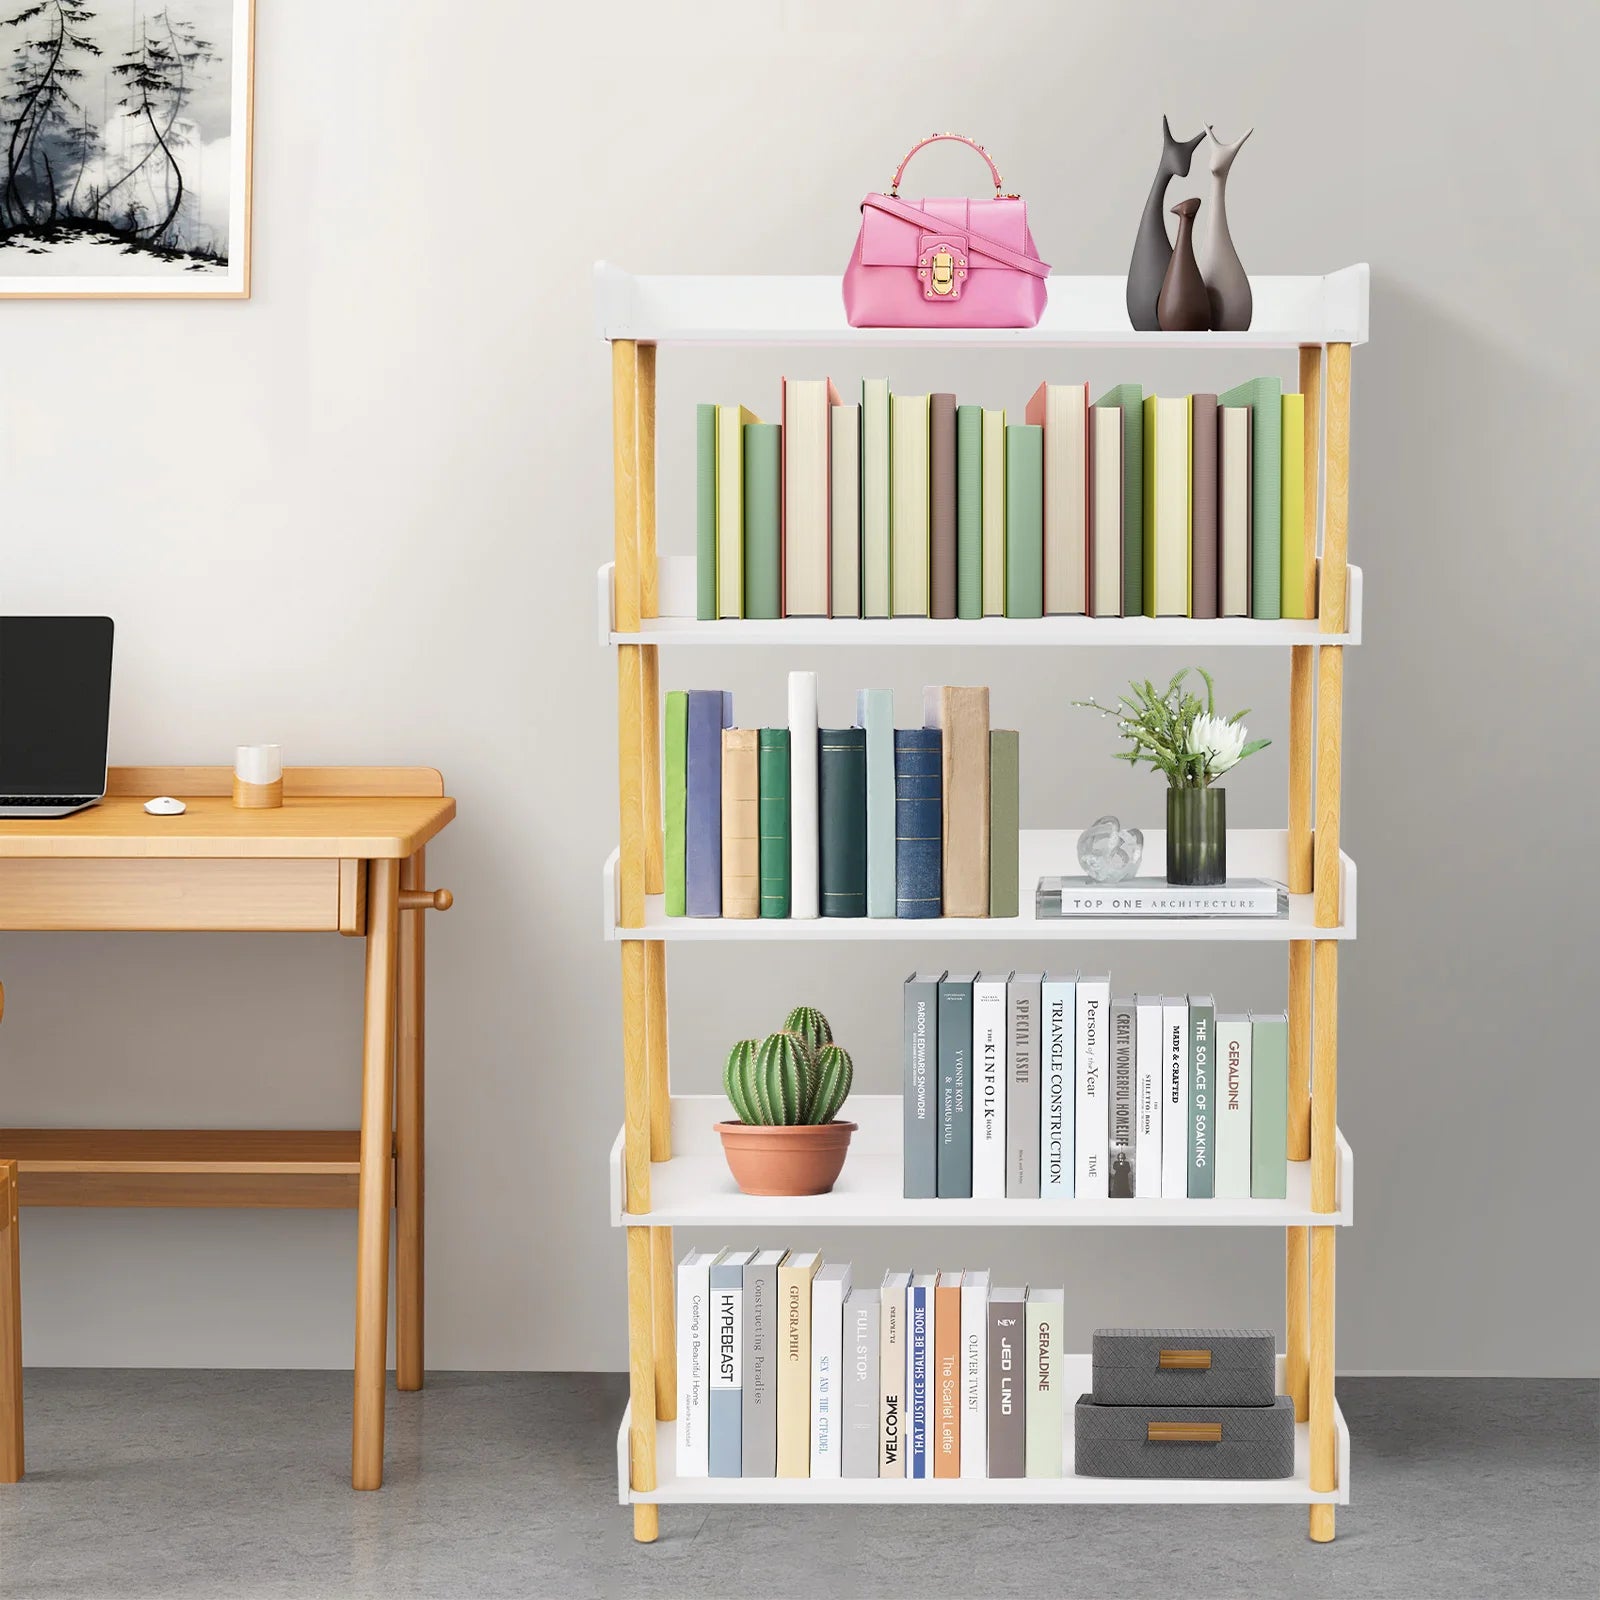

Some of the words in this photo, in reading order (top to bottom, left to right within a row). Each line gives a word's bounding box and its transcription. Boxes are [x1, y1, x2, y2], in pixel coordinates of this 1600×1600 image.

[1074, 900, 1103, 909] TOP
[1112, 900, 1142, 909] ONE
[1151, 900, 1255, 908] ARCHITECTURE
[917, 1001, 926, 1034] PARDON
[1015, 999, 1029, 1047] SPECIAL
[1087, 1000, 1099, 1046] Person
[1116, 1013, 1130, 1045] CREATE
[1195, 1019, 1206, 1041] THE
[1051, 1000, 1063, 1071] TRIANGLE
[1085, 1047, 1094, 1056] of
[1172, 1025, 1180, 1053] MADE
[917, 1035, 926, 1072] EDWARD
[1015, 1052, 1029, 1084] ISSUE
[1172, 1053, 1180, 1061] &
[1195, 1045, 1206, 1090] SOLACE
[945, 1076, 952, 1084] &
[984, 1044, 995, 1118] KINFOLK
[1087, 1067, 1099, 1098] Year
[1116, 1047, 1129, 1101] WONDERFUL
[1171, 1062, 1180, 1104] CRAFTED
[1228, 1040, 1240, 1111] GERALDINE
[917, 1074, 926, 1120] SNOWDEN
[944, 1088, 952, 1122] RASMUS
[1195, 1094, 1206, 1110] OF
[944, 1123, 952, 1145] JUUL
[1050, 1074, 1063, 1185] CONSTRUCTION
[1115, 1103, 1129, 1147] HOMELIFE
[1195, 1115, 1206, 1168] SOAKING
[1088, 1154, 1097, 1178] TIME
[691, 1295, 701, 1331] Creating
[753, 1279, 765, 1351] Constructing
[857, 1310, 867, 1342] FULL
[915, 1307, 925, 1334] DONE
[997, 1319, 1016, 1327] NEW
[720, 1295, 734, 1382] HYPEBEAST
[915, 1335, 925, 1347] BE
[969, 1334, 978, 1375] OLIVER
[1001, 1337, 1012, 1371] JED
[692, 1340, 701, 1378] Beautiful
[819, 1356, 829, 1372] SEX
[856, 1345, 867, 1382] STOP.
[914, 1349, 925, 1379] SHALL
[943, 1356, 955, 1378] The
[1038, 1322, 1050, 1392] GERALDINE
[692, 1380, 700, 1406] Home
[754, 1356, 764, 1405] Paradies
[819, 1376, 829, 1393] AND
[968, 1377, 978, 1413] TWIST
[1001, 1377, 1012, 1415] LIND
[819, 1397, 829, 1413] THE
[914, 1382, 925, 1424] JUSTICE
[943, 1379, 954, 1421] Scarlet
[886, 1395, 898, 1464] WELCOME
[914, 1426, 925, 1455] THAT
[942, 1423, 953, 1455] Letter
